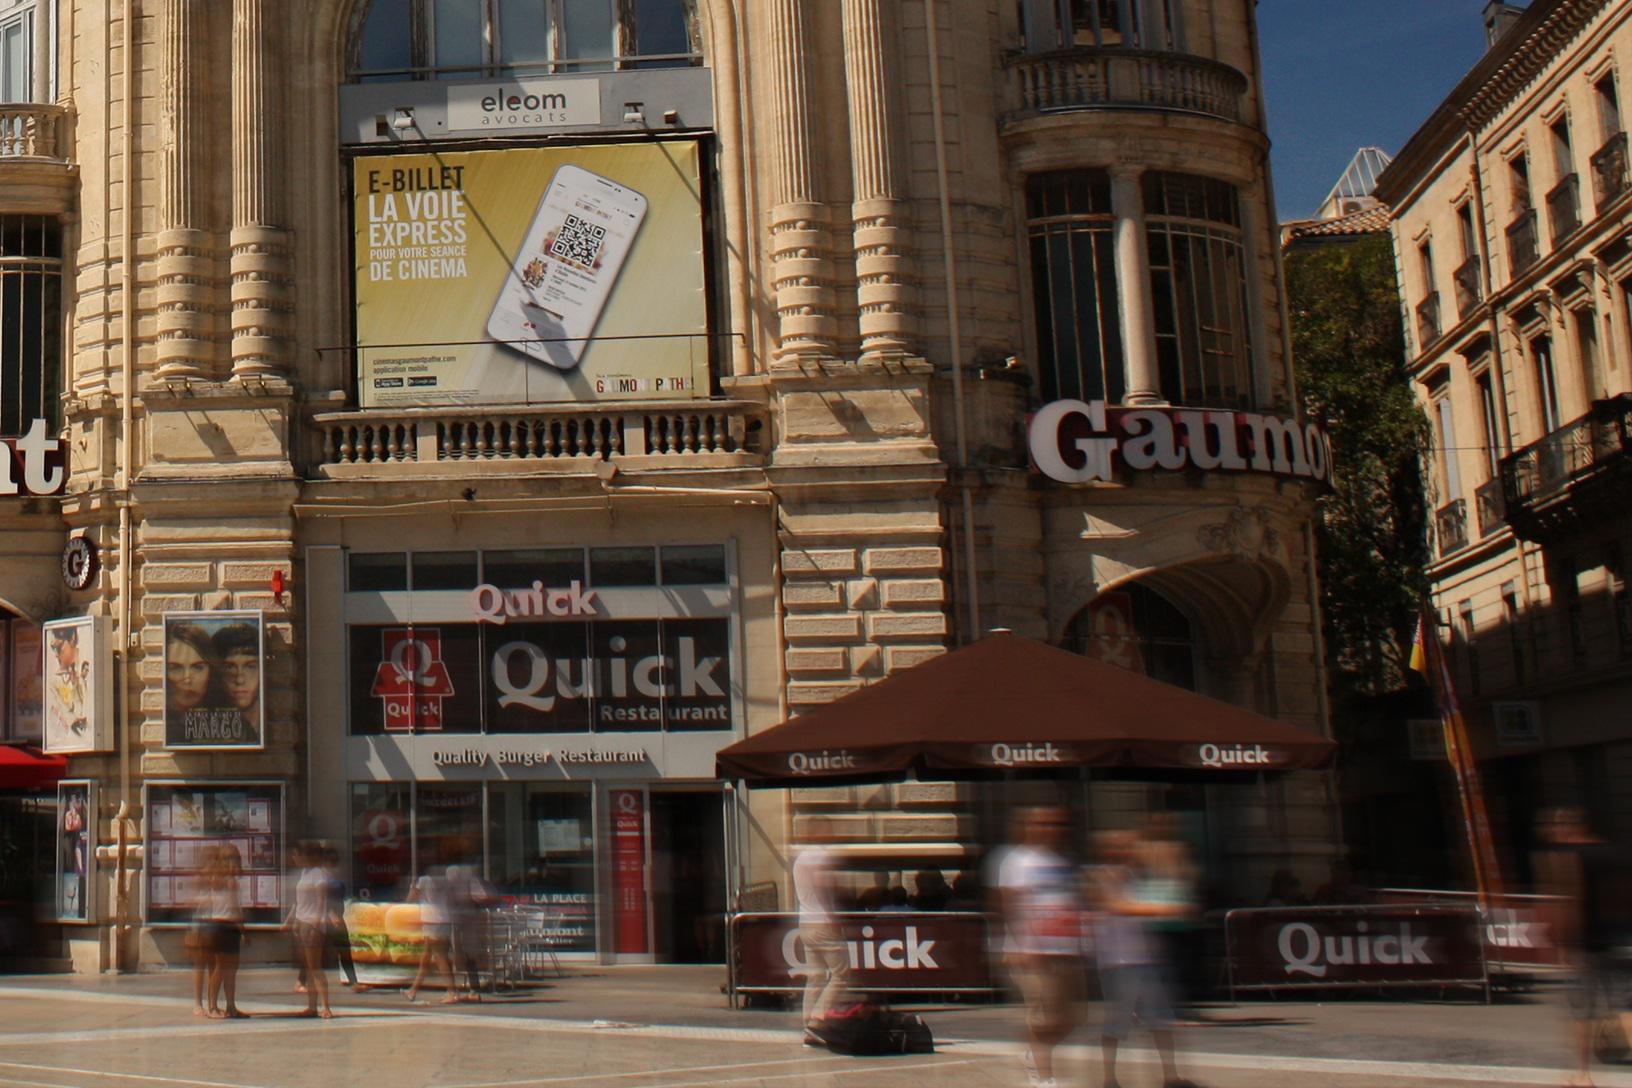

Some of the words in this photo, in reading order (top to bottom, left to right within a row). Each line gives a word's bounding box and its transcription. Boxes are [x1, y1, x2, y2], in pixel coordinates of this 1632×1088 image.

[481, 88, 567, 112] eleom
[481, 113, 567, 125] avocats
[369, 166, 464, 193] E-BILLET
[369, 194, 398, 222] LA
[405, 191, 466, 220] VOIE
[370, 220, 466, 247] EXPRESS
[370, 248, 395, 260] POUR
[399, 246, 428, 259] VOTRE
[431, 245, 466, 257] SEANCE
[371, 261, 393, 281] DE
[399, 258, 467, 280] CINEMA
[472, 580, 598, 625] Quick
[491, 636, 726, 711] Quick
[387, 701, 439, 717] Quick
[600, 704, 728, 721] Restaurant
[431, 749, 488, 766] Quality
[498, 750, 550, 766] Burger
[559, 749, 645, 762] Restaurant
[788, 751, 855, 775] Quick
[991, 743, 1060, 766] Quick
[1199, 743, 1269, 767] Quick
[534, 894, 548, 903] LA
[552, 894, 587, 903] PLACE
[1278, 921, 1434, 977] Quick
